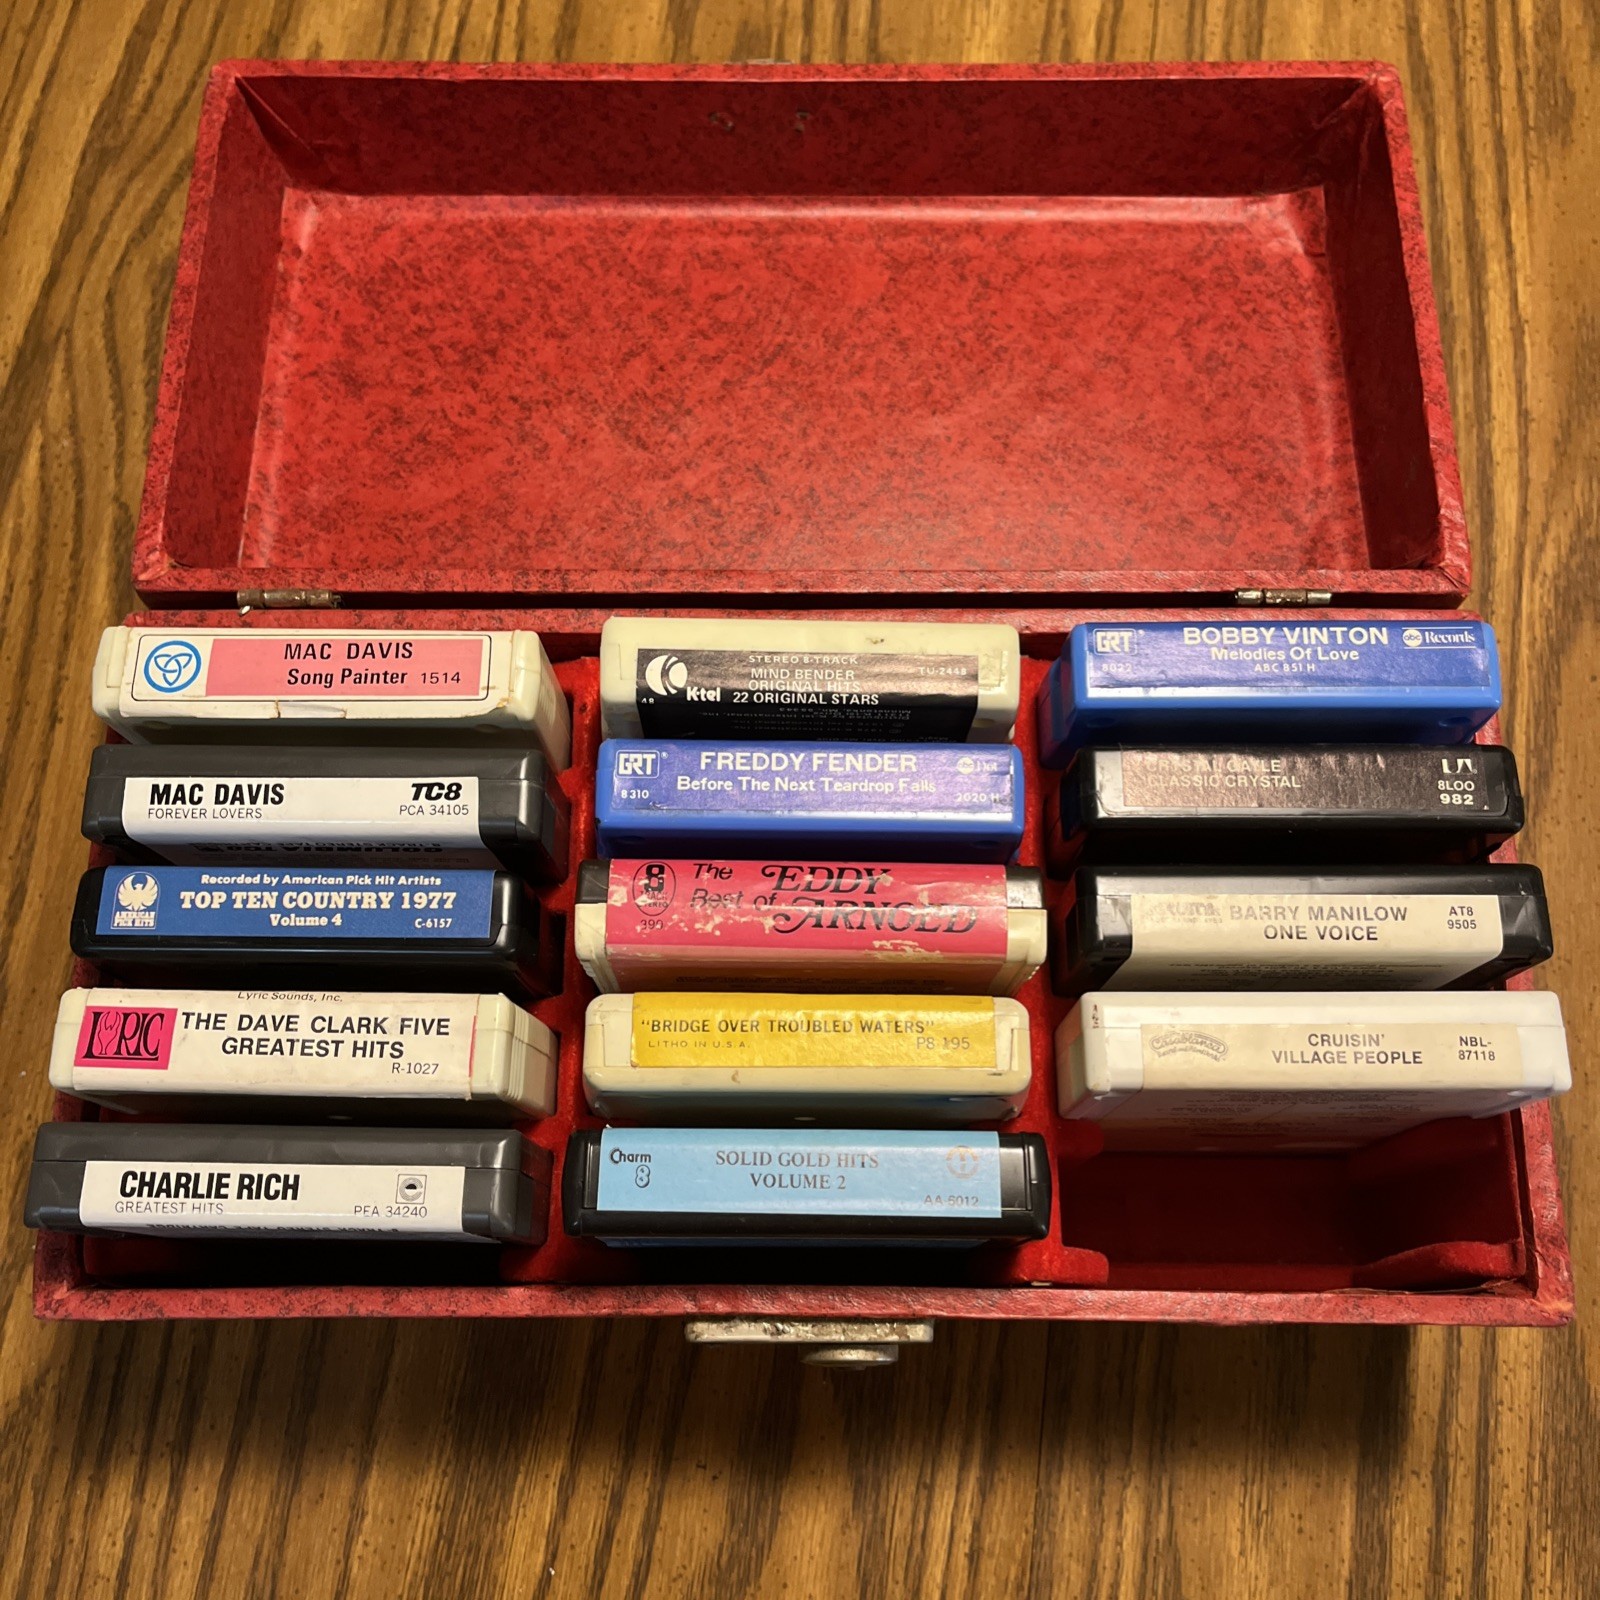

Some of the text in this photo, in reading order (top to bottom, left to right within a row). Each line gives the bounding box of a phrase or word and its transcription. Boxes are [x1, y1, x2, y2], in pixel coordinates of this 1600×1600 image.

[1097, 632, 1132, 652] GRT
[1183, 627, 1389, 645] BOBBY VINTON
[1424, 631, 1476, 644] Records
[284, 641, 414, 660] MAC DAVIS
[1210, 646, 1359, 661] Melodies Of Love
[748, 655, 858, 665] STEREO 8-TRACK
[1254, 663, 1279, 672] ABC
[1307, 663, 1316, 672] H
[287, 668, 461, 688] Song Painter 1514
[751, 668, 855, 680] MIND BENDER
[748, 680, 861, 693] ORIGINAL HITS
[733, 692, 879, 705] 22 ORIGINAL STARS
[619, 753, 656, 775] GRT
[700, 752, 917, 773] FREDDY FENDER
[677, 776, 936, 795] Before The Next Teardrop Falls
[1149, 775, 1301, 788] CLASSIC CRYSTAL
[150, 783, 284, 805] MAC DAVIS
[410, 782, 463, 801] TC8
[956, 793, 987, 802] 2020
[1440, 793, 1474, 805] 982
[148, 808, 262, 819] FOREVER LOVERS
[399, 804, 469, 816] PCA 34105
[644, 864, 665, 892] 8
[693, 863, 733, 881] The
[761, 864, 893, 894] EDDY
[201, 873, 442, 887] Recorded by American Pick Hit Artists
[180, 891, 457, 910] TOP TEN COUNTRY 1977
[690, 888, 778, 912] Best of
[772, 898, 978, 935] ARNOLD
[1230, 906, 1298, 922] BARRY
[1308, 906, 1408, 922] MANILOW
[1449, 906, 1474, 917] AT8
[270, 913, 342, 927] Volume 4
[414, 918, 453, 929] C-6157
[1447, 919, 1477, 930] 9505
[1264, 925, 1378, 942] ONE VOICE
[238, 992, 343, 1002] Lyric Sounds, Inc.
[181, 1012, 450, 1036] THE DAVE CLARK FIVE
[717, 1019, 760, 1033] OVER
[767, 1019, 853, 1034] TROUBLED
[648, 1040, 688, 1048] LITHO
[694, 1040, 707, 1048] IN
[917, 1036, 935, 1050] P8
[1308, 1033, 1386, 1047] CRUISIN'
[1459, 1036, 1492, 1047] NBL-
[221, 1037, 404, 1059] GREATEST HITS
[1272, 1050, 1423, 1065] VILLAGE PEOPLE
[1458, 1050, 1496, 1062] 87118
[391, 1062, 439, 1075] R-1027
[610, 1148, 652, 1164] Charm
[715, 1150, 879, 1168] SOLID GOLD HITS
[635, 1164, 651, 1188] 8
[749, 1173, 847, 1190] VOLUME 2
[119, 1170, 299, 1201] CHARLIE RICH
[924, 1194, 944, 1206] AA
[114, 1202, 224, 1215] GREATEST HITS
[354, 1205, 428, 1219] PEA 34240
